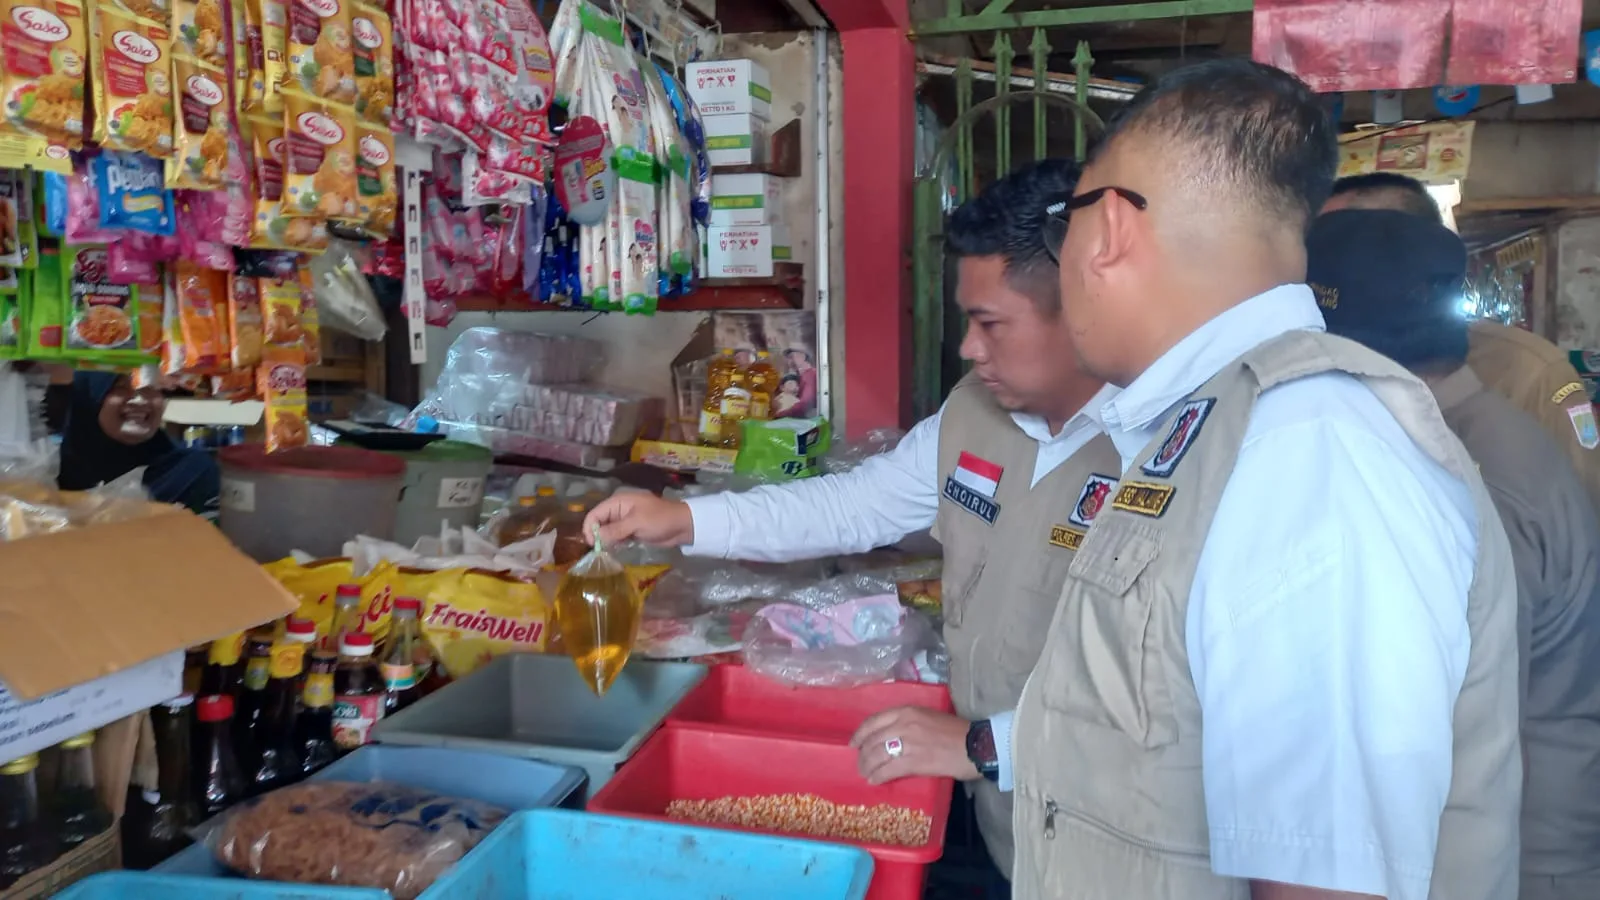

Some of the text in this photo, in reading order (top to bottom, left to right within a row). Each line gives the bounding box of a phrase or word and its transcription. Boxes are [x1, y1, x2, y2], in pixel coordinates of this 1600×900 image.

[19, 10, 64, 35] Sasa
[119, 34, 153, 57] Sasa
[191, 79, 218, 99] Sasa
[304, 116, 337, 138] Sasa
[946, 480, 993, 519] CHOIRUL
[428, 603, 543, 643] FraisWell
